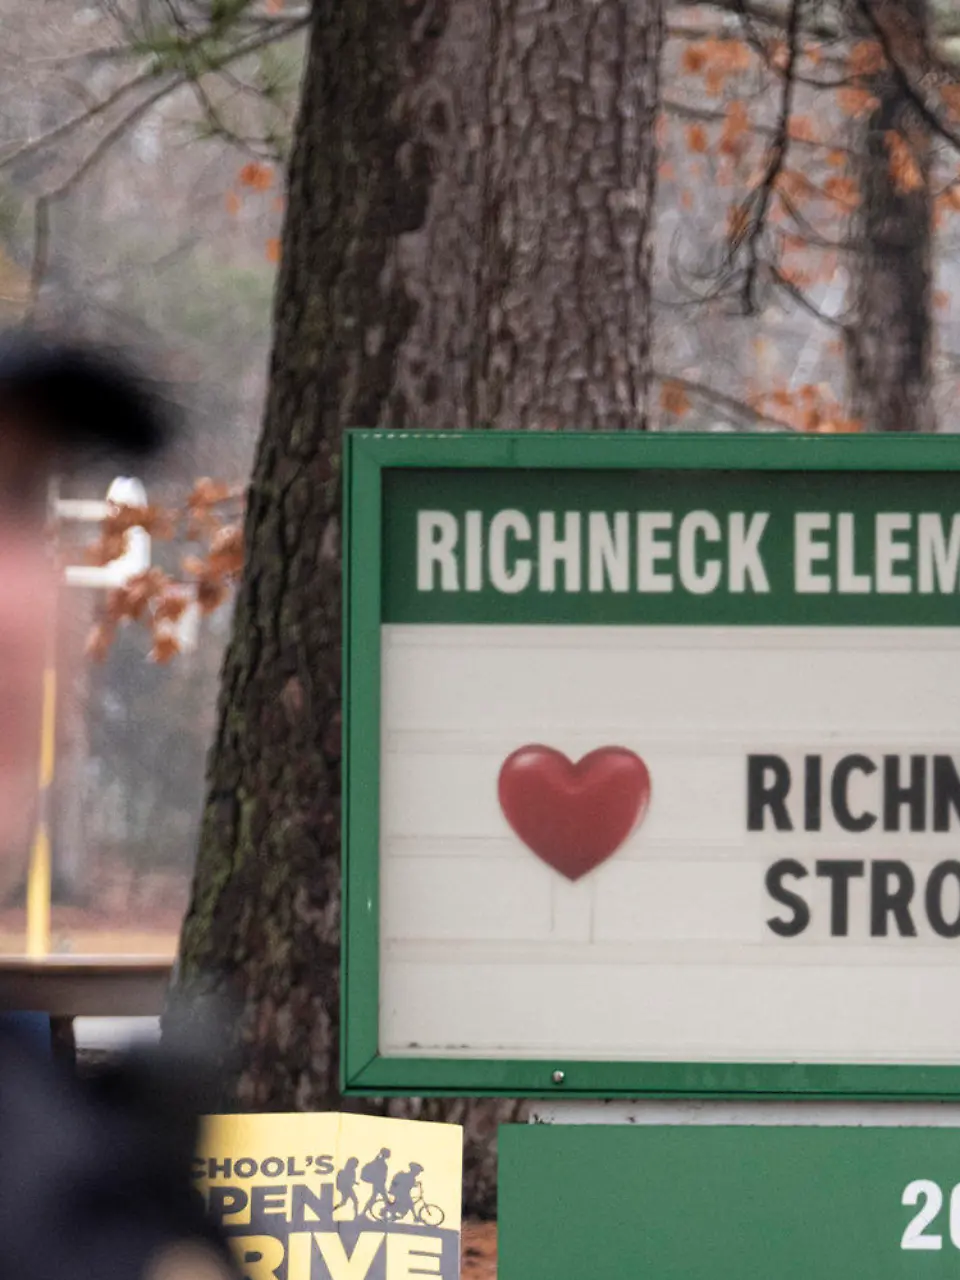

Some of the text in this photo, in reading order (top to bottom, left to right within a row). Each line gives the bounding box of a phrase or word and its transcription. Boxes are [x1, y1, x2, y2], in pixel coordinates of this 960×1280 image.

[416, 508, 771, 594] RICHNECK
[188, 1154, 335, 1179] CHOOL'S
[206, 1183, 334, 1226] PEN
